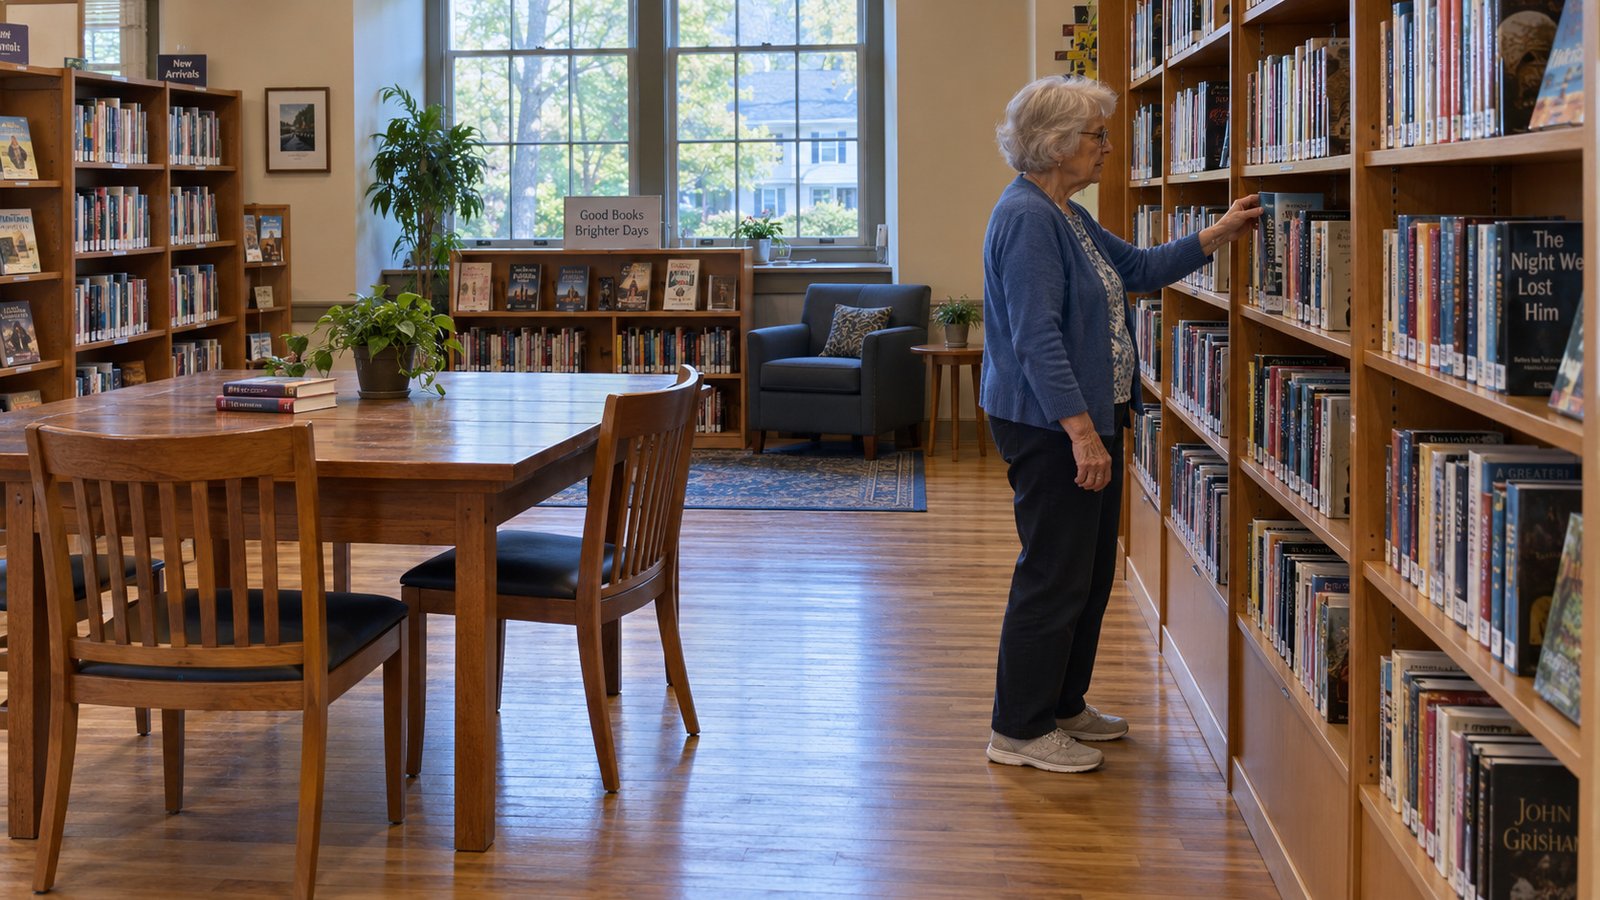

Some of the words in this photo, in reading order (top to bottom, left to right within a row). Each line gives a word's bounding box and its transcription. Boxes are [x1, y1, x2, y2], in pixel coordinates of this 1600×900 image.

[173, 59, 193, 68] New
[165, 69, 200, 79] Arrivals
[580, 209, 609, 221] Good
[612, 209, 644, 221] Books
[575, 224, 620, 239] Brighter
[623, 224, 649, 239] Days
[1532, 230, 1564, 249] The
[1511, 252, 1555, 275] Night
[1559, 252, 1584, 271] We
[1518, 277, 1553, 296] Lost
[1525, 302, 1559, 321] Him
[1496, 467, 1504, 478] A
[1514, 798, 1572, 826] JOHN
